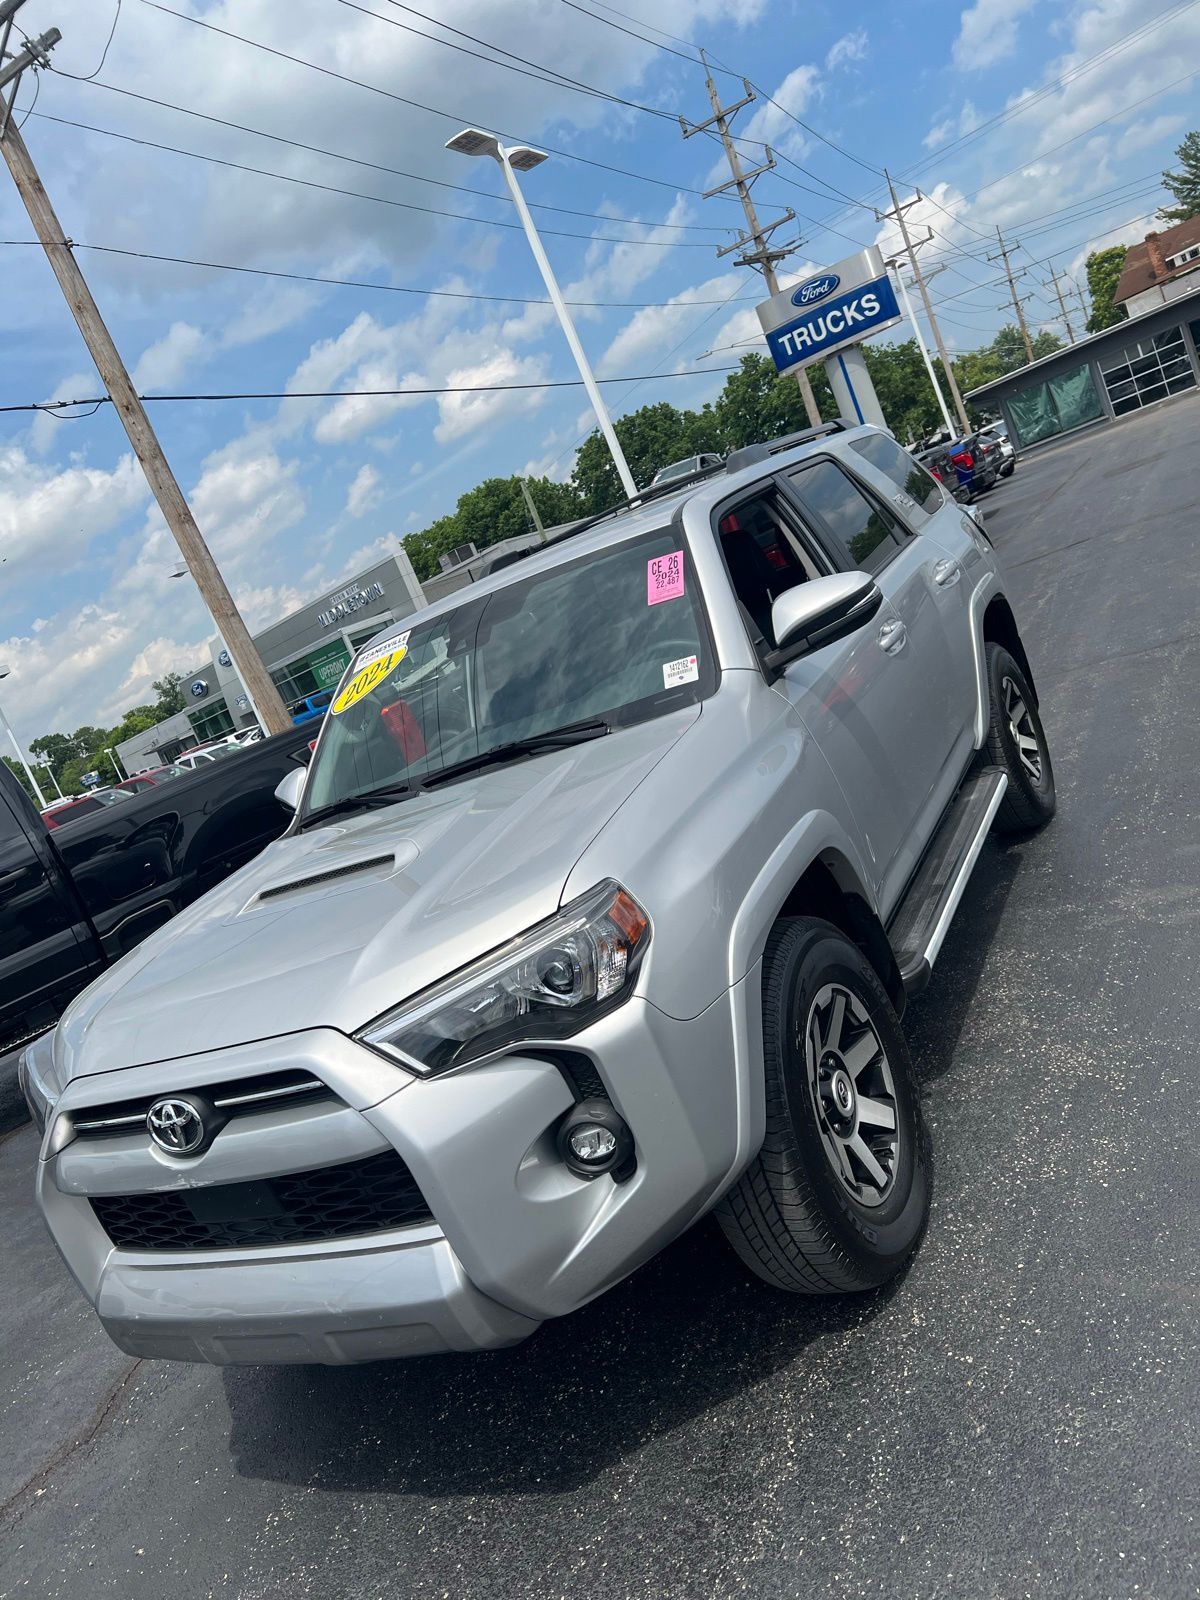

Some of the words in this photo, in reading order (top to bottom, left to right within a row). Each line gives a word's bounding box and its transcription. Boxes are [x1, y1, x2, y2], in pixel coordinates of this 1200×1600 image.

[801, 280, 830, 302] Ford
[778, 293, 881, 356] TRUCKS
[651, 560, 663, 576] CE
[668, 555, 679, 569] 26
[655, 568, 680, 582] 2024
[318, 582, 385, 627] MIDDLETOWN
[343, 653, 394, 707] 2024
